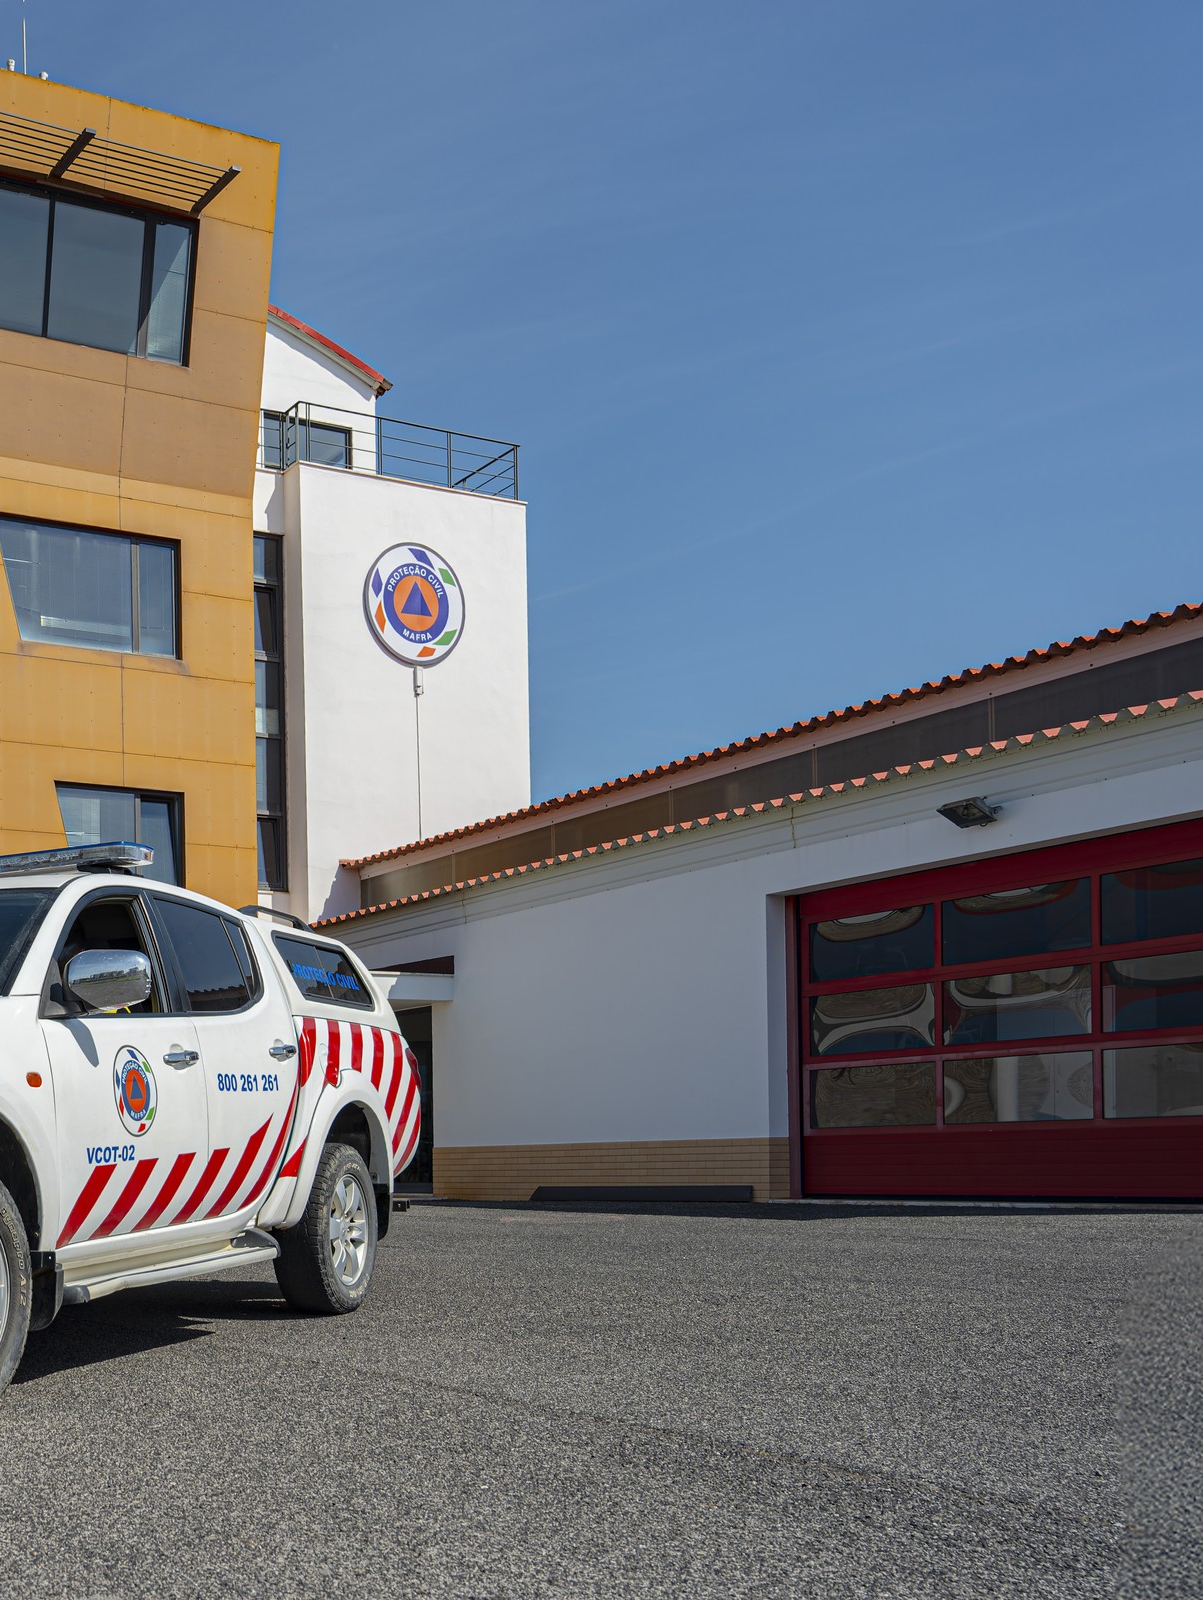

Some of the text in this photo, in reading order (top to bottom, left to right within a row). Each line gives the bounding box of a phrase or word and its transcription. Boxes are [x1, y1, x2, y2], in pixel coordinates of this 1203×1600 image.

[387, 565, 444, 599] PROTEÇÃO CIVIL
[402, 628, 432, 642] MAFRA
[336, 973, 360, 991] CIVIL
[217, 1073, 279, 1092] 800 261 261
[86, 1144, 135, 1165] VCOT-02
